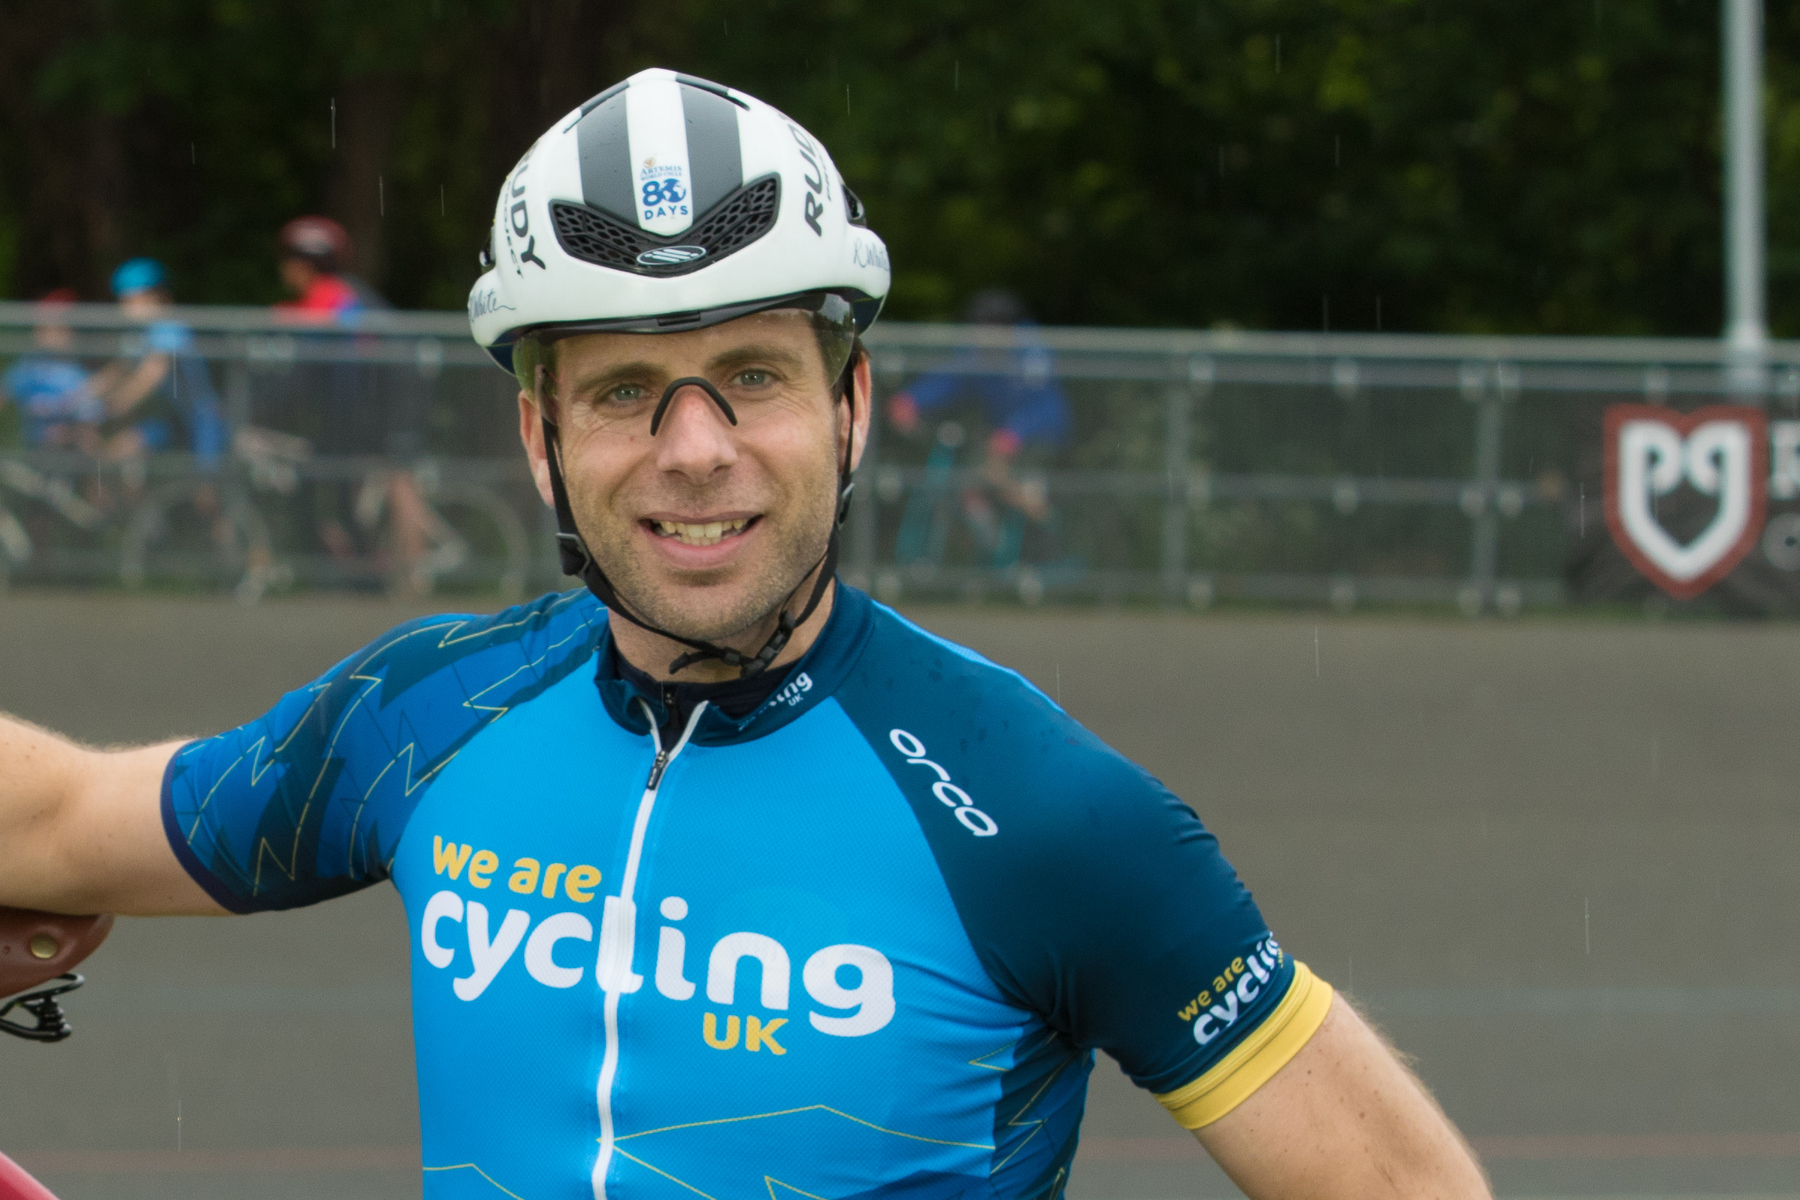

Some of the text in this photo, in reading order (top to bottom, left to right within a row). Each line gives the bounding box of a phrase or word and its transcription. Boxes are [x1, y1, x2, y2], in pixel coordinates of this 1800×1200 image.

[640, 165, 682, 176] ARTEMIS
[644, 205, 689, 221] DAYS
[889, 728, 999, 836] orca
[432, 835, 602, 903] we are
[421, 890, 896, 1038] cycling
[1177, 989, 1213, 1022] we
[1212, 956, 1246, 993] are
[703, 1012, 790, 1056] UK
